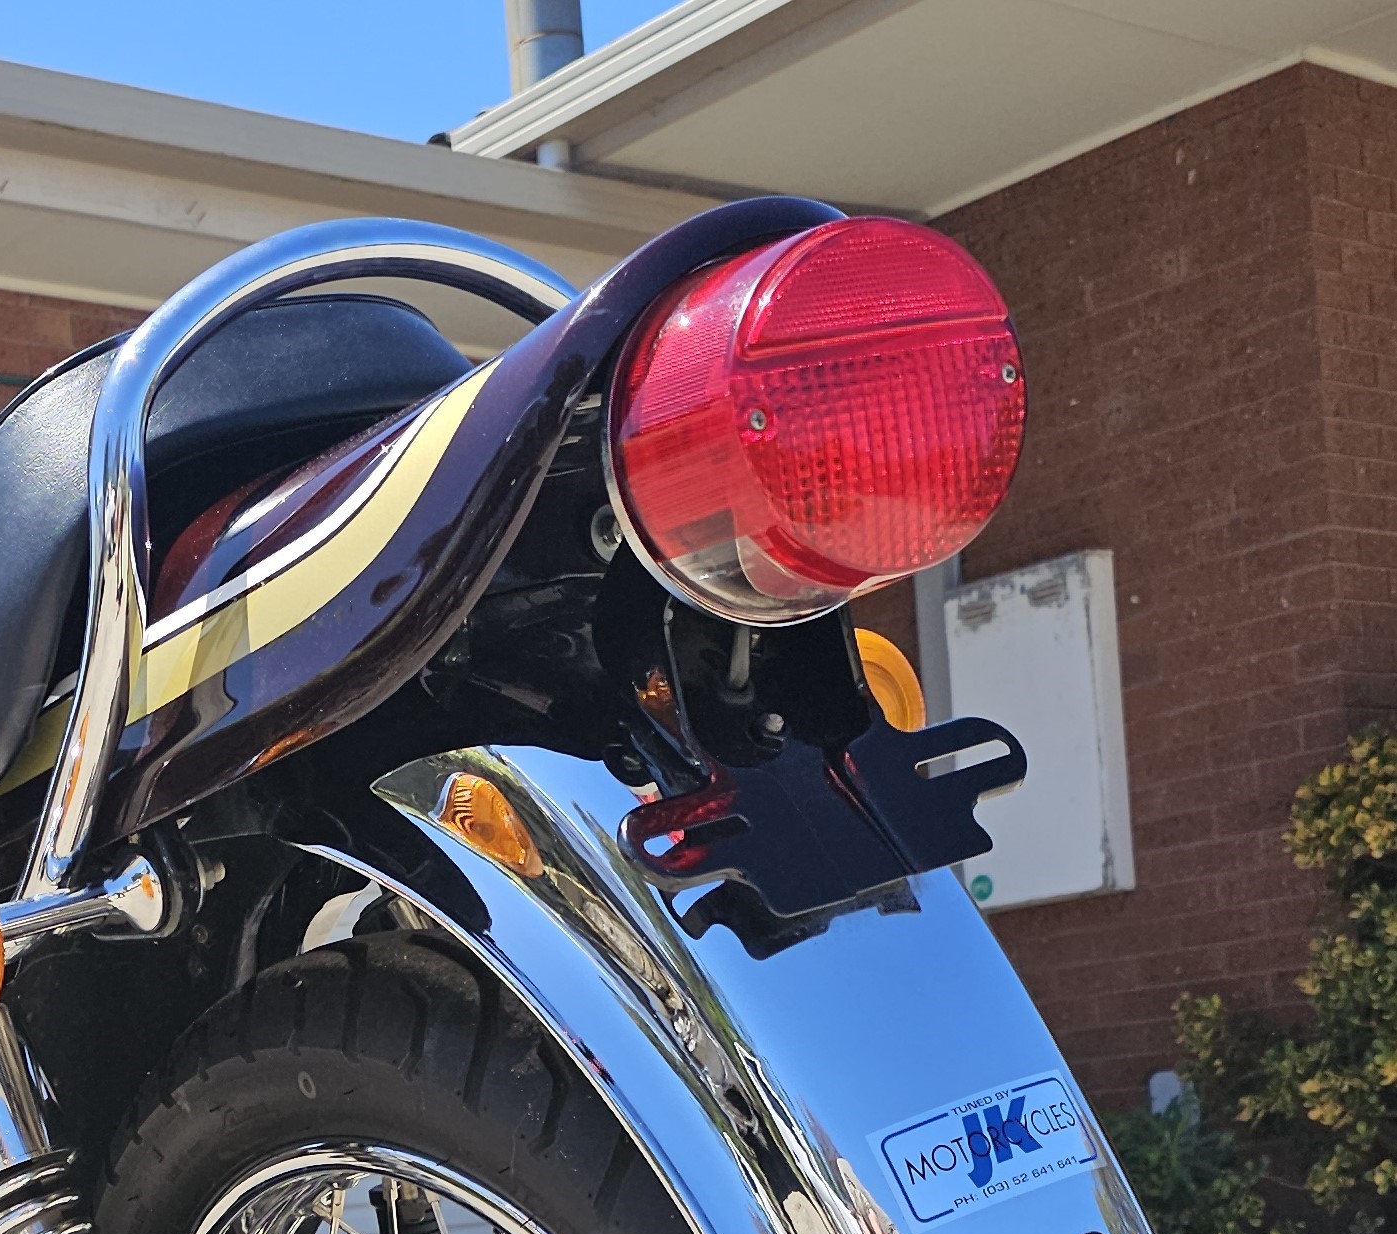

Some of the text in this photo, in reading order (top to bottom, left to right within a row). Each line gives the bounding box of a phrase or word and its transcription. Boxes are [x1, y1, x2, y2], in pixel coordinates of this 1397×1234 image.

[951, 1089, 1011, 1115] TUNED BY
[904, 1102, 1076, 1185] MOTORCYCLES
[961, 1094, 1044, 1188] JK
[954, 1193, 979, 1208] PH:
[982, 1181, 1010, 1199] (03)
[1012, 1172, 1030, 1186] 52
